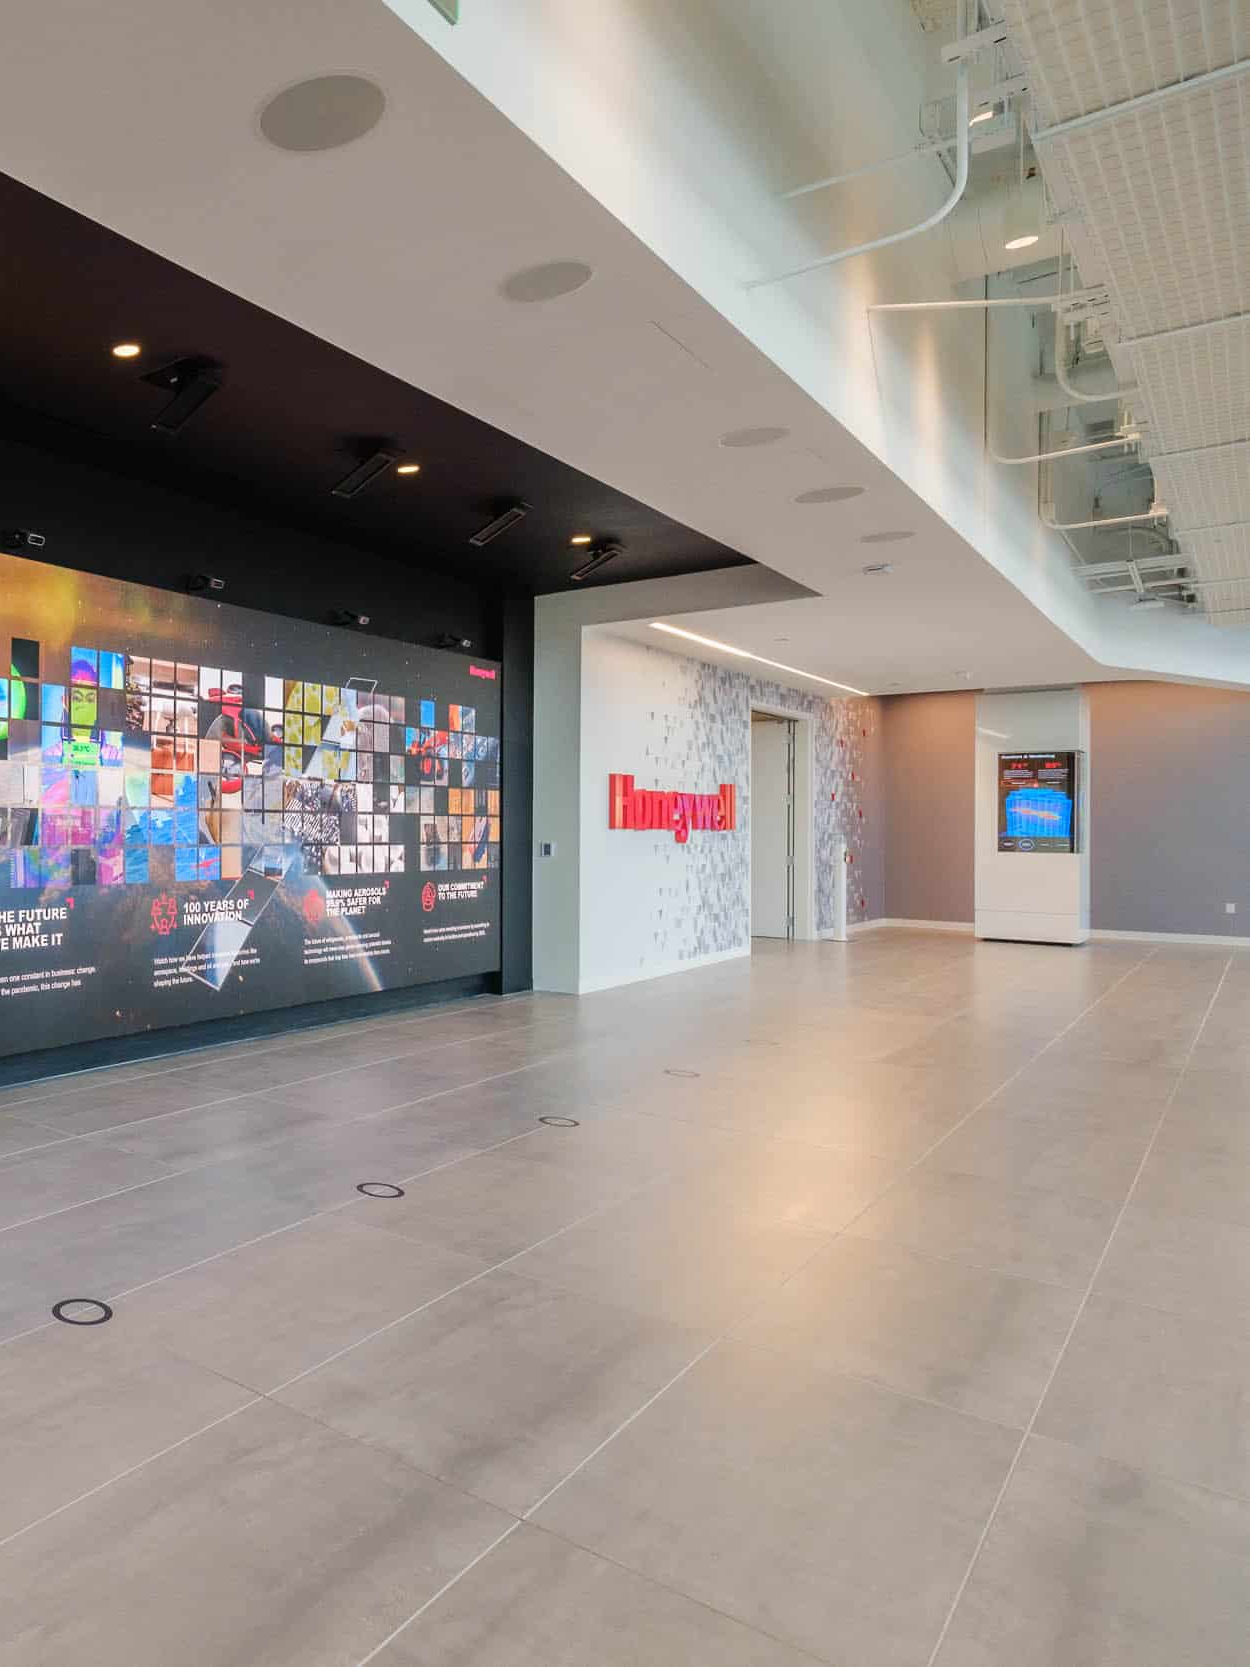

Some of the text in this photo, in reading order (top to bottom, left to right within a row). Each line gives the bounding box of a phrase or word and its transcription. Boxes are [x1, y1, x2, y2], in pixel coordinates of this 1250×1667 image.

[608, 773, 736, 843] Honeywell
[183, 898, 250, 913] 100 YEARS OF
[19, 907, 67, 922] FUTURE
[183, 910, 243, 926] INNOVATION
[5, 922, 42, 937] WHAT
[12, 935, 48, 950] MAKE
[51, 933, 63, 945] IT
